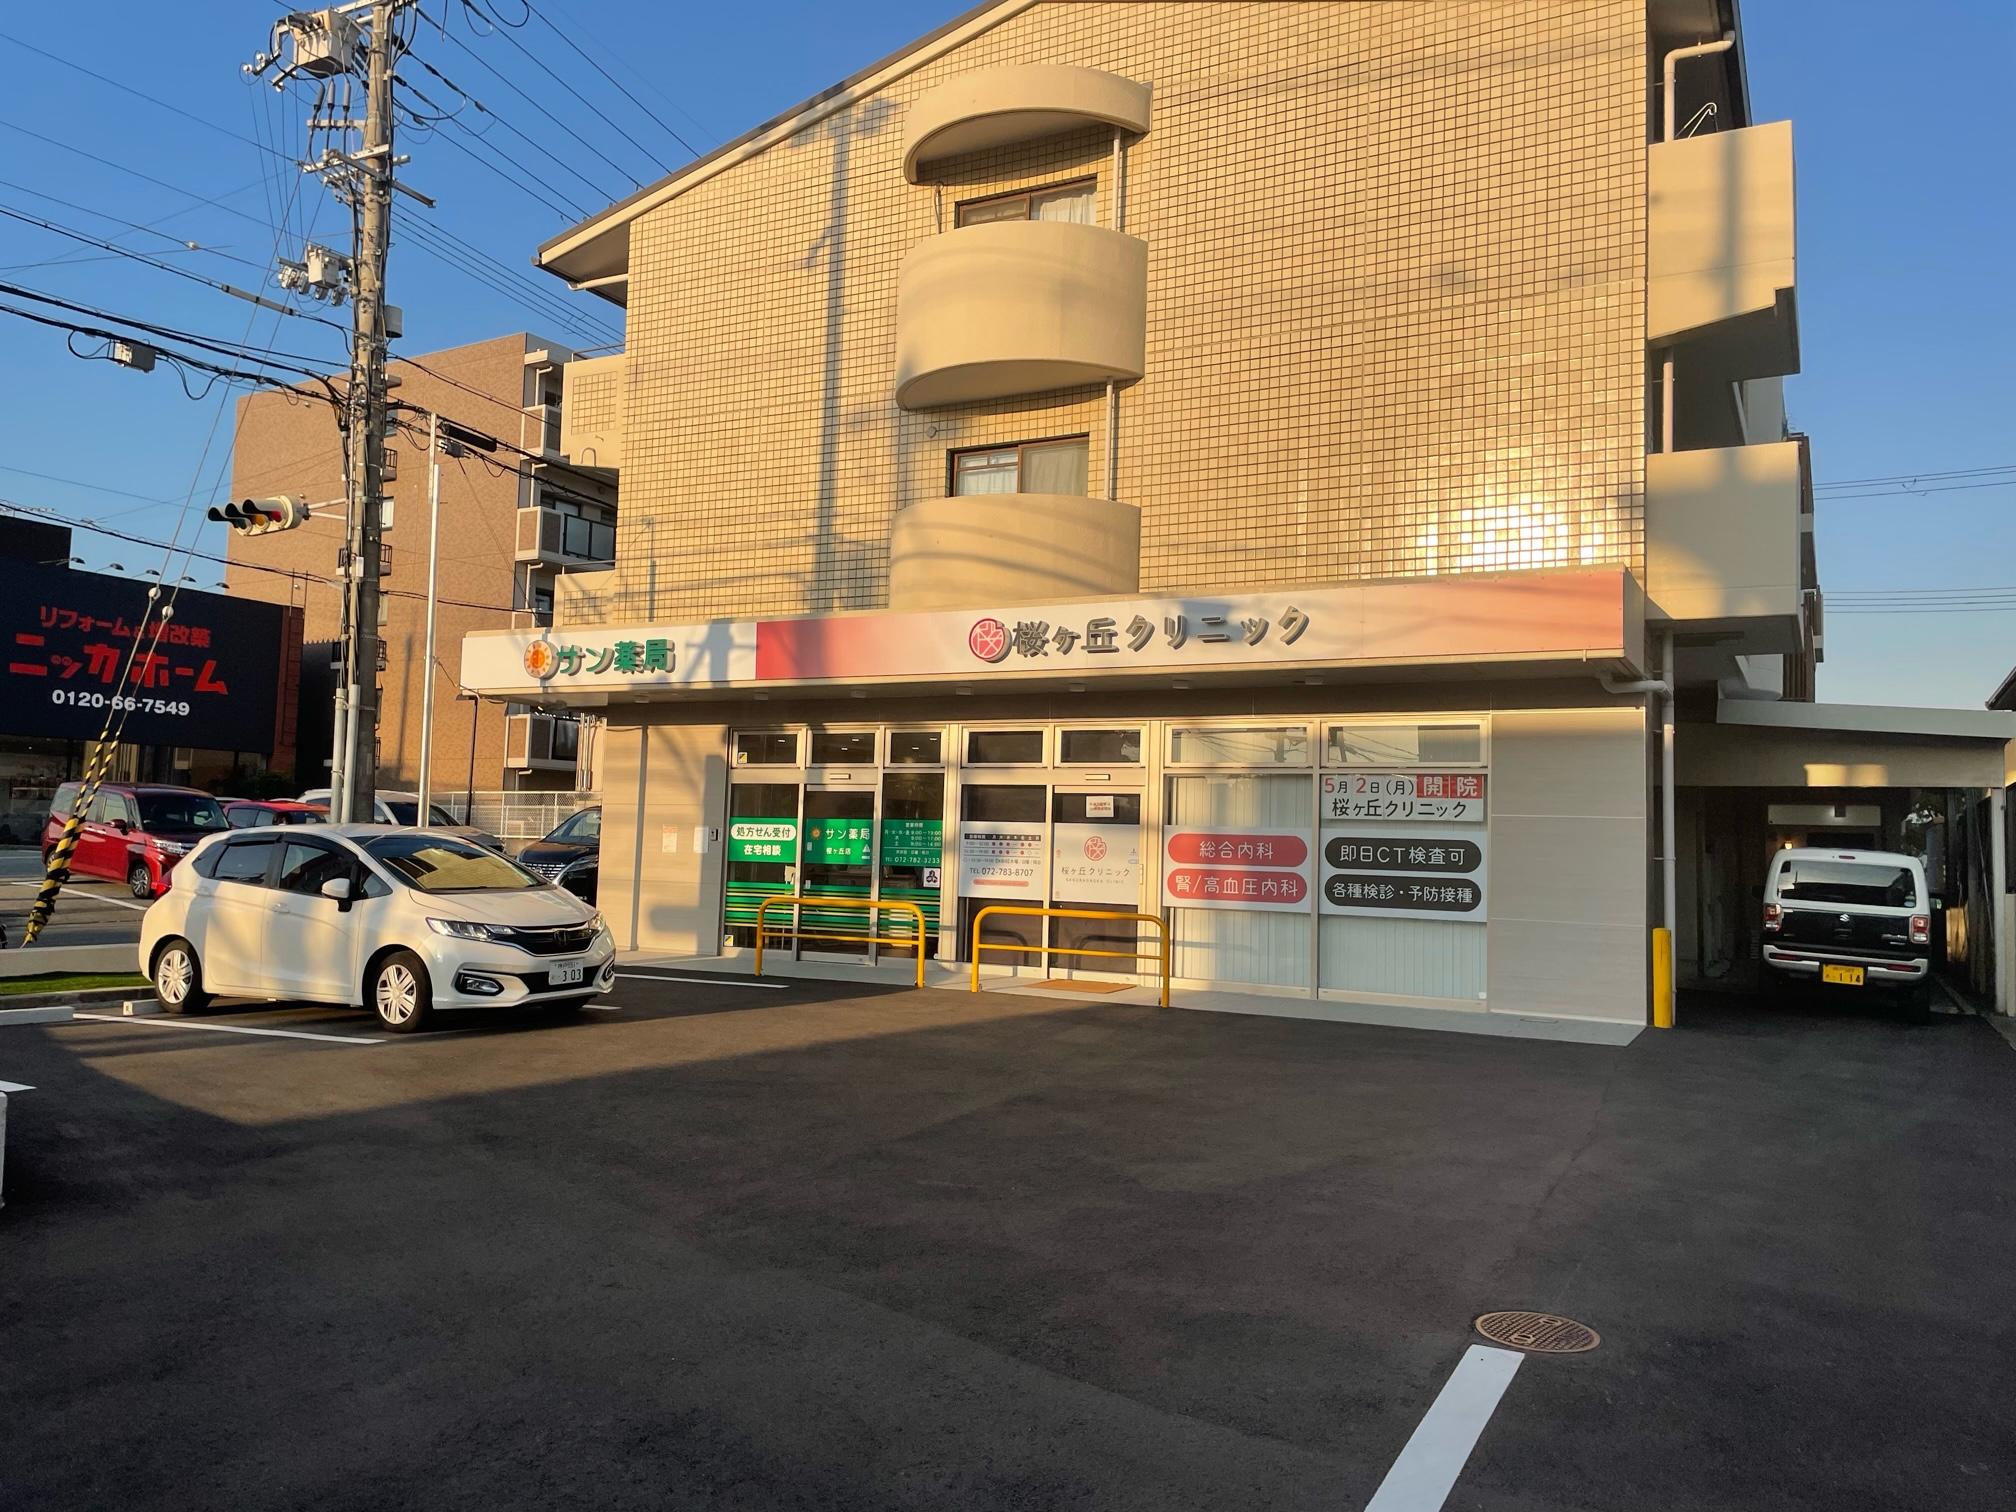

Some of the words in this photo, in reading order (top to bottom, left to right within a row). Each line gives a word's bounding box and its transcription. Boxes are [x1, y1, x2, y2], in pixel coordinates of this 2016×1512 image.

[1012, 605, 1310, 657] 桜ヶ丘クリニック
[9, 632, 229, 695] ニッカホーム
[556, 638, 675, 676] サン薬局
[52, 689, 191, 716] 0120-66-7549
[1332, 798, 1467, 818] 桜ヶ丘クリニック
[736, 826, 791, 838] 処方せん受付
[825, 828, 870, 840] サン薬局
[743, 844, 781, 856] 在宅相談
[1199, 840, 1274, 860] 総合内科
[1339, 844, 1466, 866] 即日CT検査可
[969, 867, 980, 875] TEL
[1175, 875, 1298, 897] 腎/高血圧内科
[1332, 882, 1474, 903] 各種検診・予防接種
